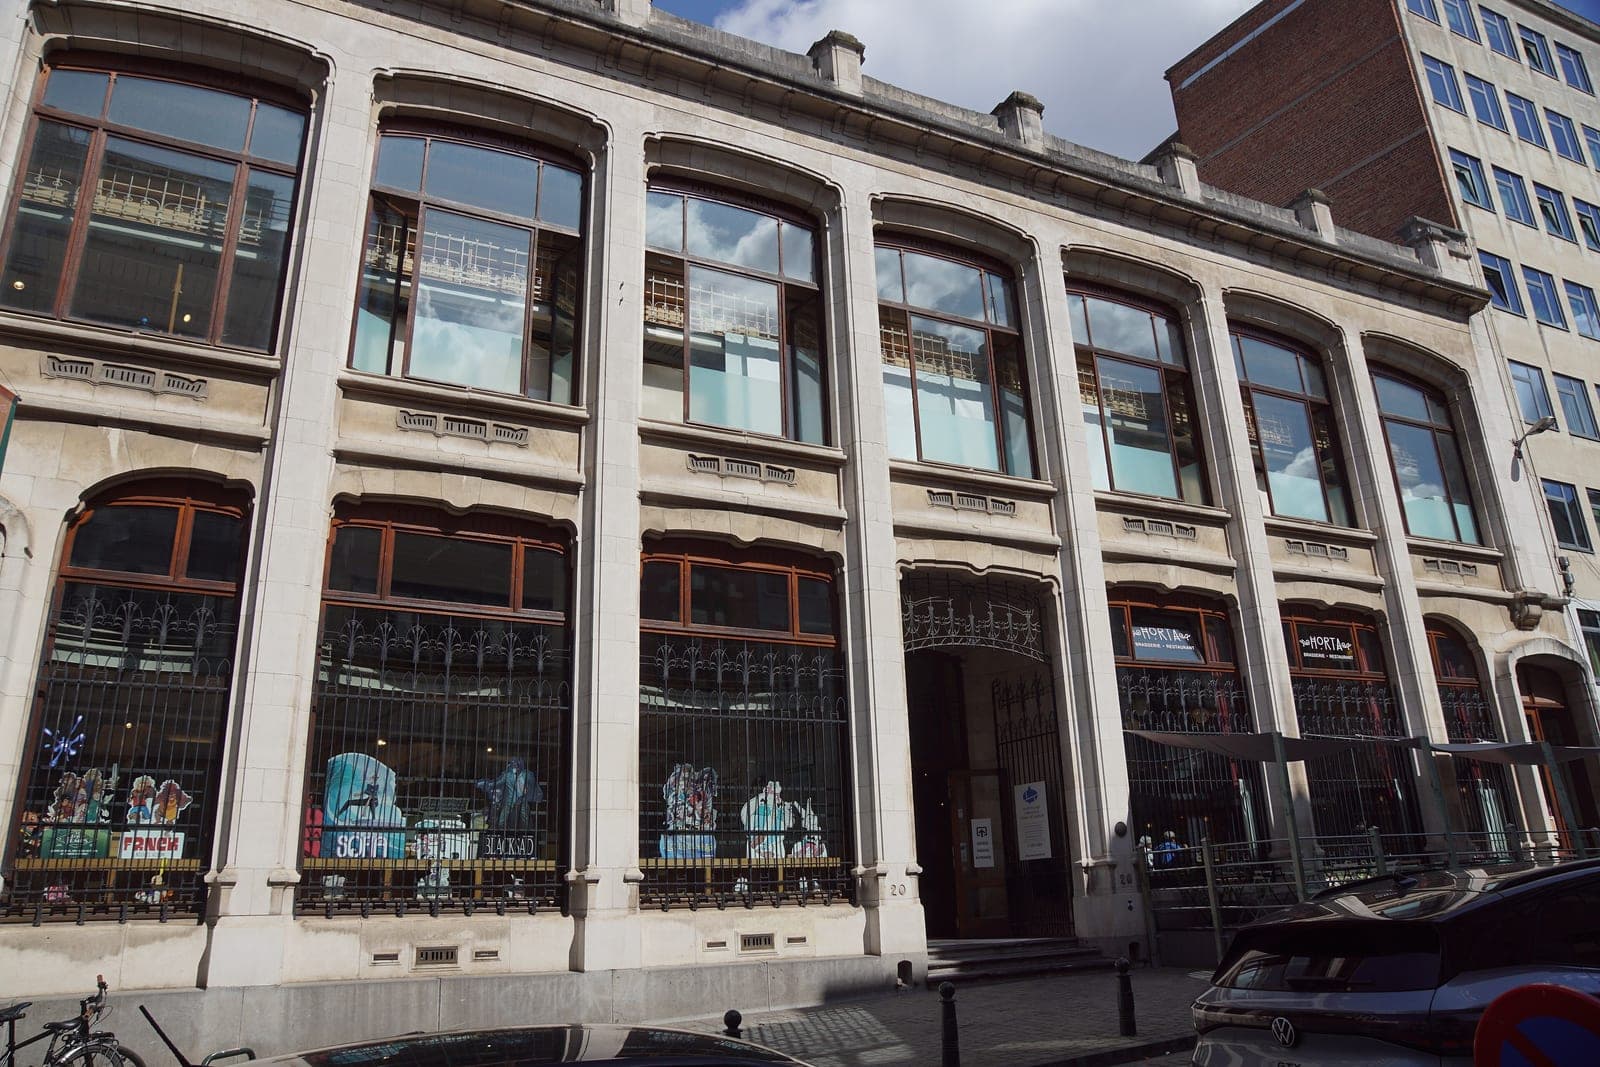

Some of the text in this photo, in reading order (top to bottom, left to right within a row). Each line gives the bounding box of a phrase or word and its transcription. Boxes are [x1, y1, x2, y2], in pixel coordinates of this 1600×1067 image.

[1140, 626, 1181, 642] HORTA
[1135, 641, 1195, 651] BRASSERIE RESTAURANT
[1309, 635, 1343, 652] HORTA
[1328, 653, 1354, 661] RESTAURANT
[484, 836, 534, 856] BLACKSAD
[890, 884, 906, 896] 20
